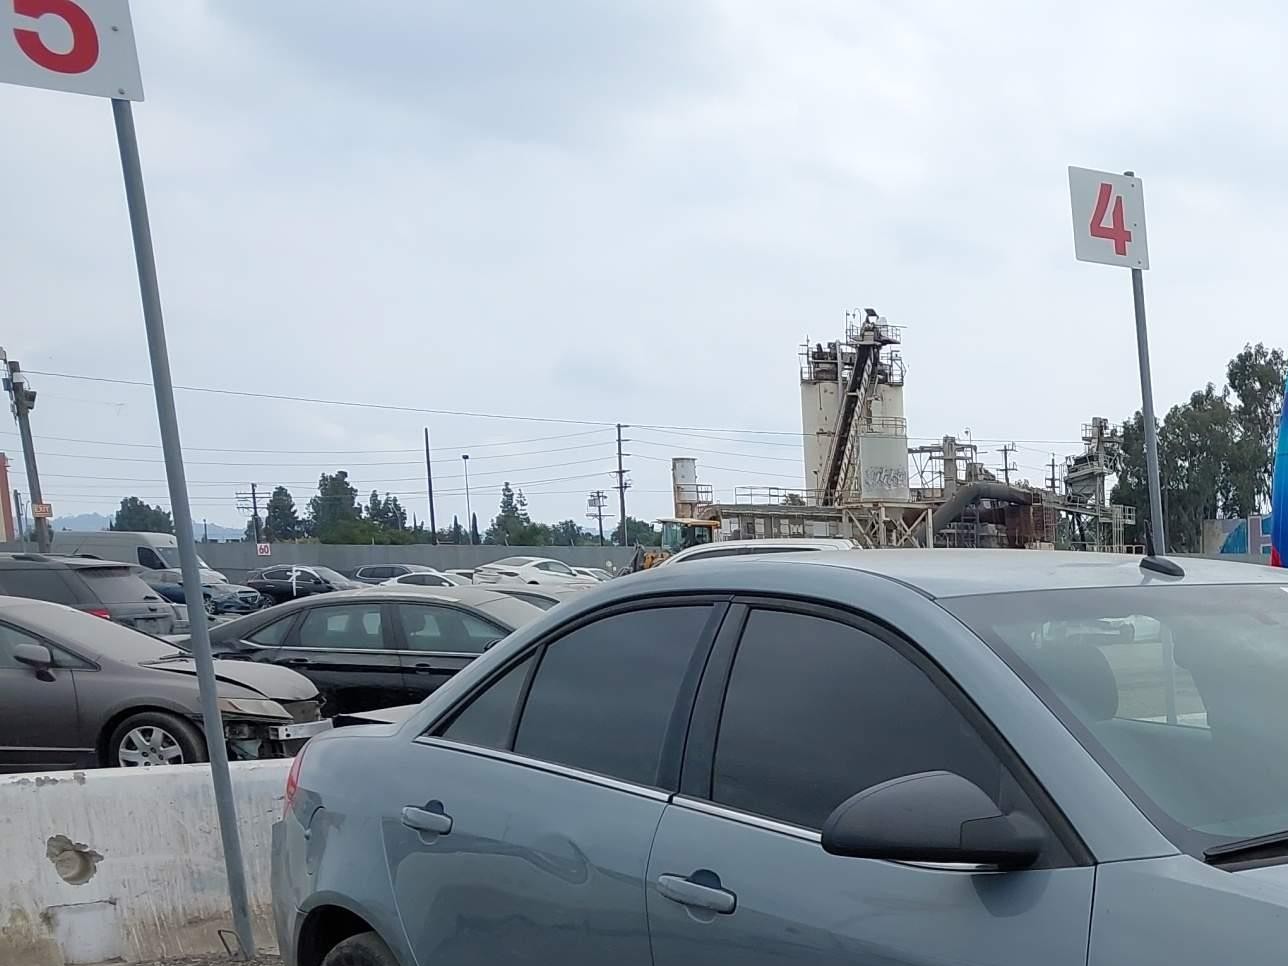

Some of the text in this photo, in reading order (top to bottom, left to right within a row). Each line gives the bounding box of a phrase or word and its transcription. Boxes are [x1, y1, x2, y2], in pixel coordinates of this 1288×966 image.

[13, 0, 99, 75] 5
[1090, 182, 1132, 256] 4
[259, 544, 269, 554] 60
